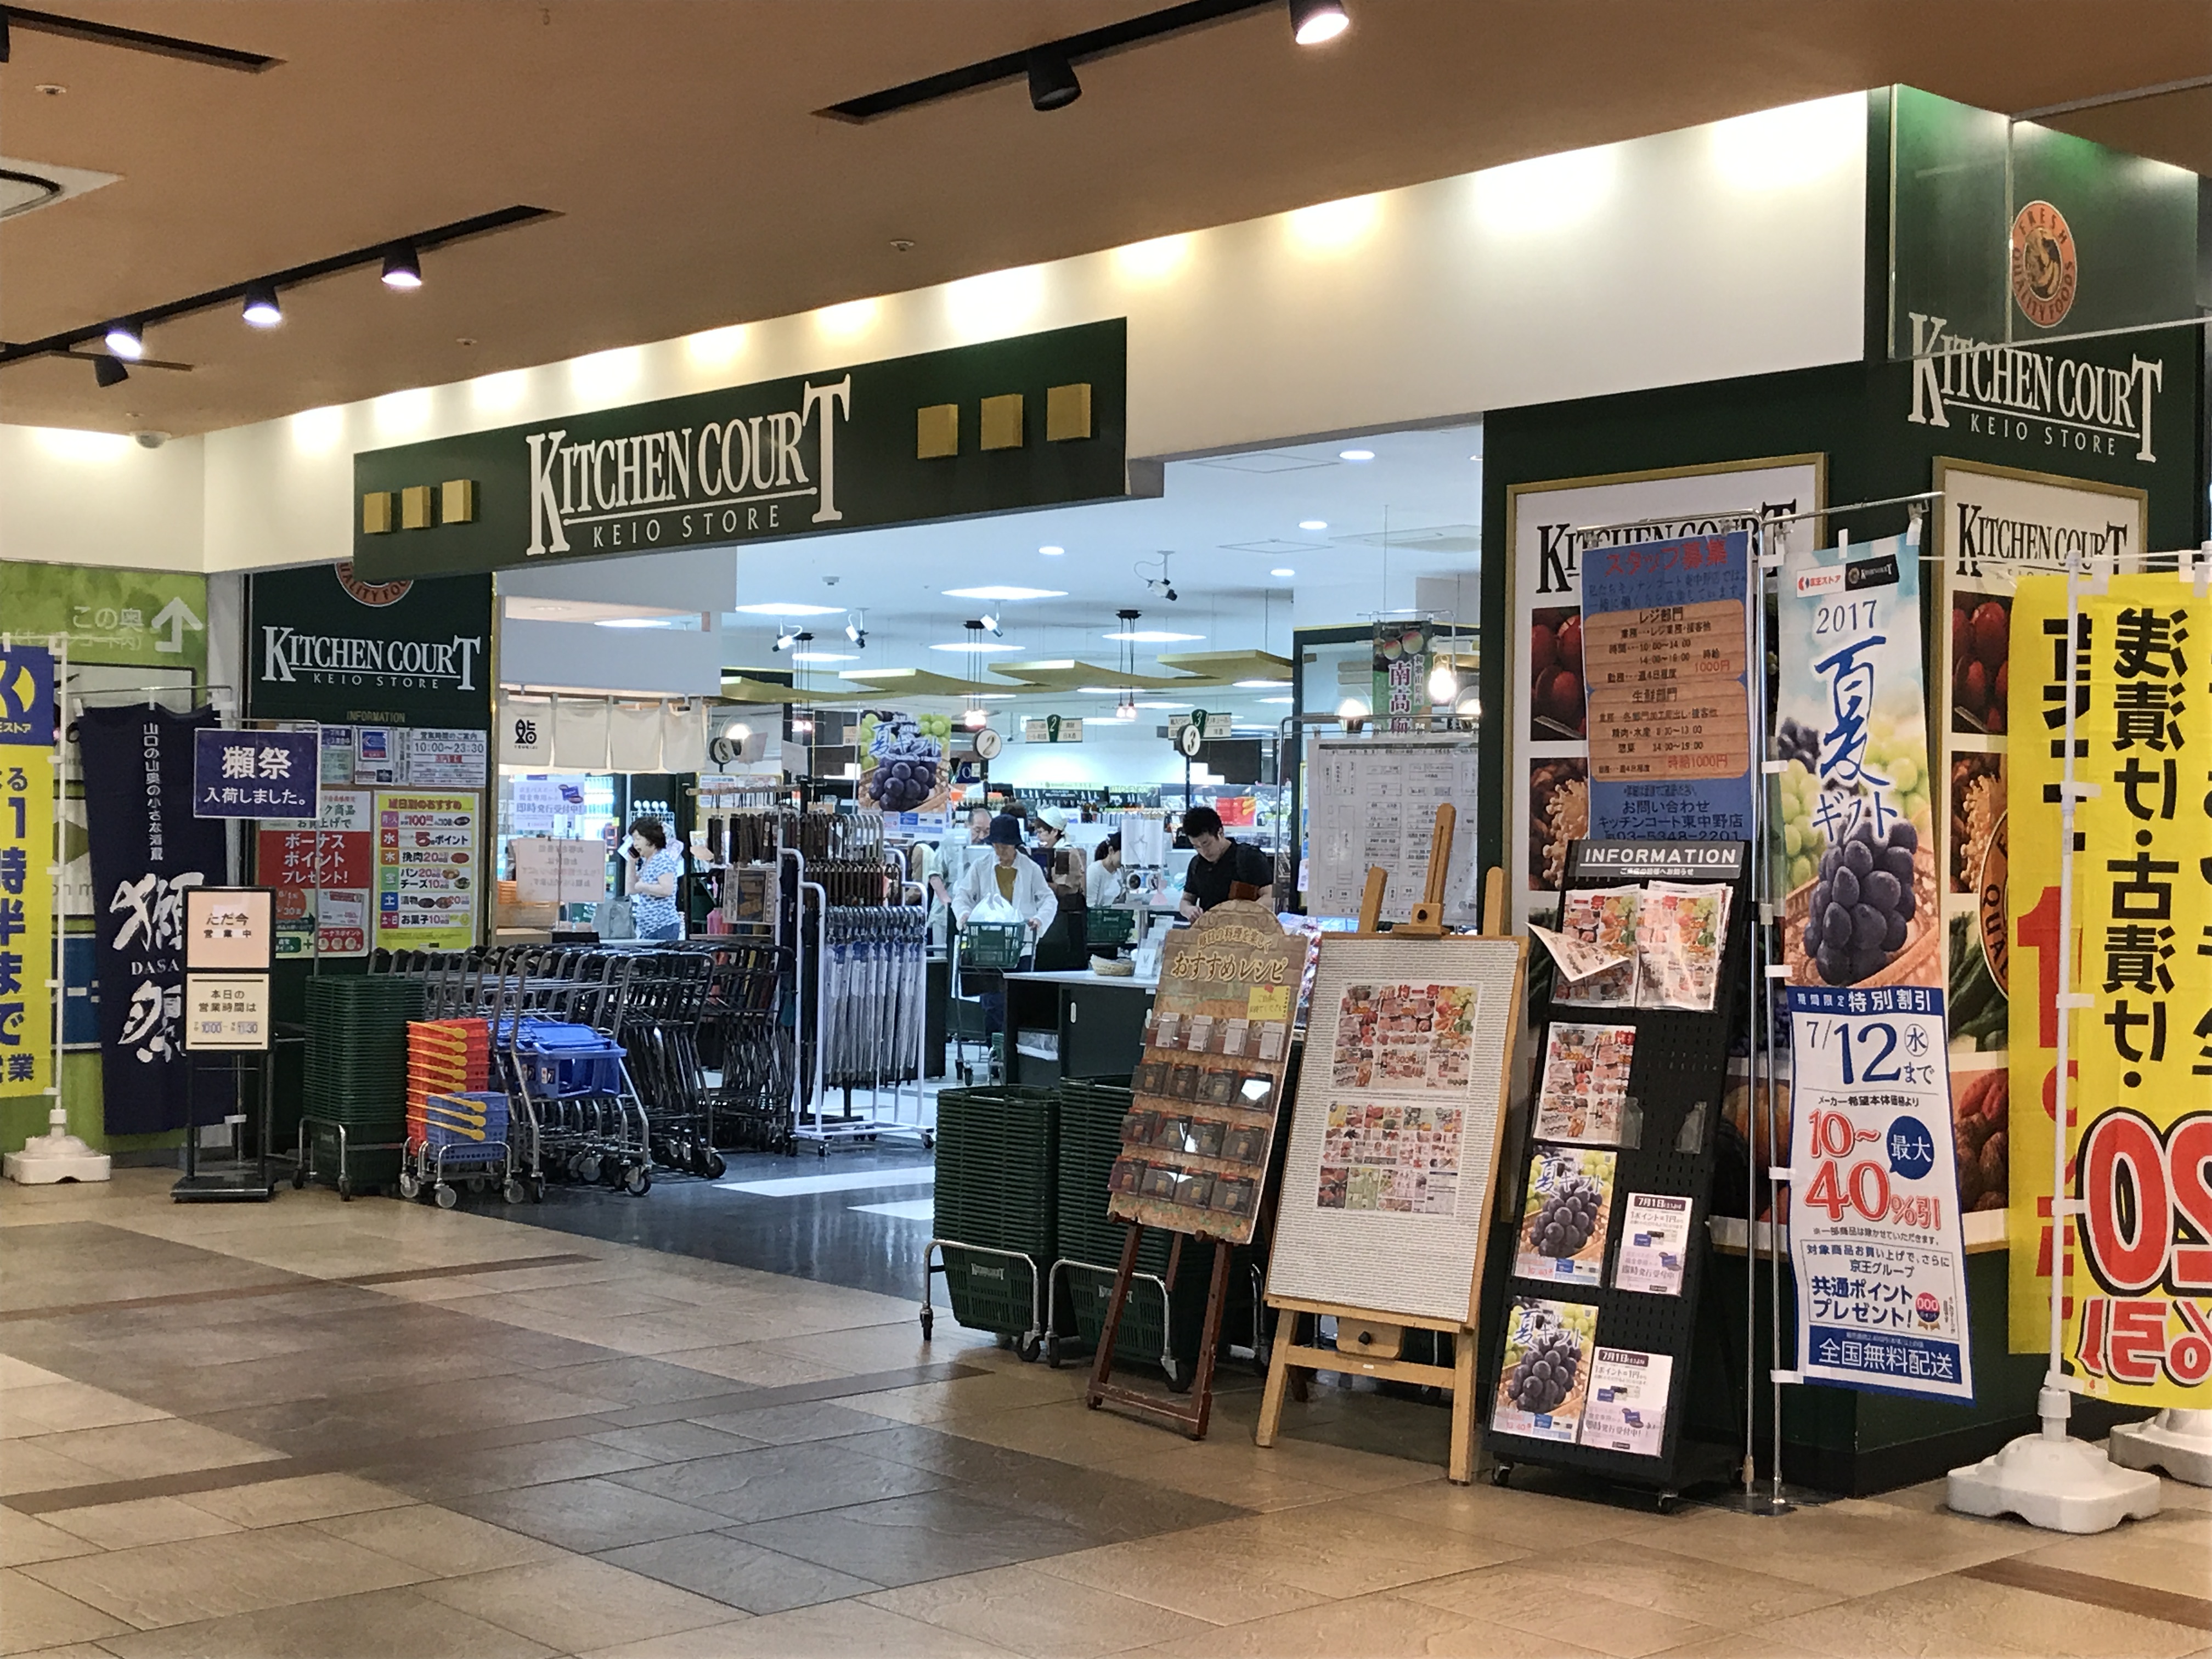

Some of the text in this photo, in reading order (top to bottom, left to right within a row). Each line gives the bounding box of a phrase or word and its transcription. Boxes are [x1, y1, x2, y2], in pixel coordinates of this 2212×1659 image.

[2020, 207, 2068, 245] FRESH
[2013, 247, 2074, 322] QUALITY FOODS
[1908, 312, 2163, 463] KITCHEN COURT
[1970, 413, 2115, 456] KEIO STORE
[525, 373, 851, 556] KITCHEN COURT
[592, 504, 781, 549] KEIO STORE
[1956, 503, 2052, 578] KITCHEN
[1605, 538, 1728, 578] スタッフ募集
[73, 606, 144, 632] この奥
[1816, 600, 1877, 634] 2017
[261, 625, 481, 691] KITCHEN COURT
[1694, 659, 1730, 673] 1000円
[314, 673, 439, 689] KEIO STORE
[1632, 687, 1678, 703] 生鮮部門
[346, 711, 405, 724] INFORMATION
[1049, 716, 1057, 732] 2
[1194, 710, 1203, 727] 3
[1814, 635, 1891, 787] 夏
[868, 723, 942, 758] 夏ギフト
[983, 735, 996, 755] 2
[1187, 730, 1197, 752] 3
[221, 746, 292, 781] 獺祭
[1668, 753, 1729, 770] 時給1000円
[203, 787, 306, 806] 入荷しました。
[1622, 800, 1711, 815] お問い合わせ
[1598, 814, 1744, 830] キッチンコート東中野店
[1812, 791, 1898, 843] ギフト
[285, 833, 345, 850] ボーナス
[383, 832, 396, 845] 水
[284, 851, 345, 868] ポイント
[1584, 848, 1736, 864] INFORMATION
[206, 912, 249, 926] ただ今
[204, 929, 252, 938] 営業中
[199, 1002, 256, 1013] 営業時間は
[211, 990, 245, 1000] 本日の
[1805, 1019, 1901, 1085] 7/12
[0, 1053, 34, 1083] 業
[1903, 1062, 1936, 1085] まで
[1818, 1094, 1920, 1107] メーカー希望本体価格より
[1891, 1134, 1932, 1163] 最大
[1534, 1158, 1604, 1197] 夏ギフト
[1802, 1159, 1942, 1231] 40%引
[1849, 1259, 1915, 1278] 京王グループ
[1811, 1275, 1913, 1305] 共通ポイント
[1813, 1298, 1913, 1329] プレゼント!
[1513, 1310, 1584, 1350] 夏ギフト
[1819, 1338, 1954, 1380] 全国無料配送
